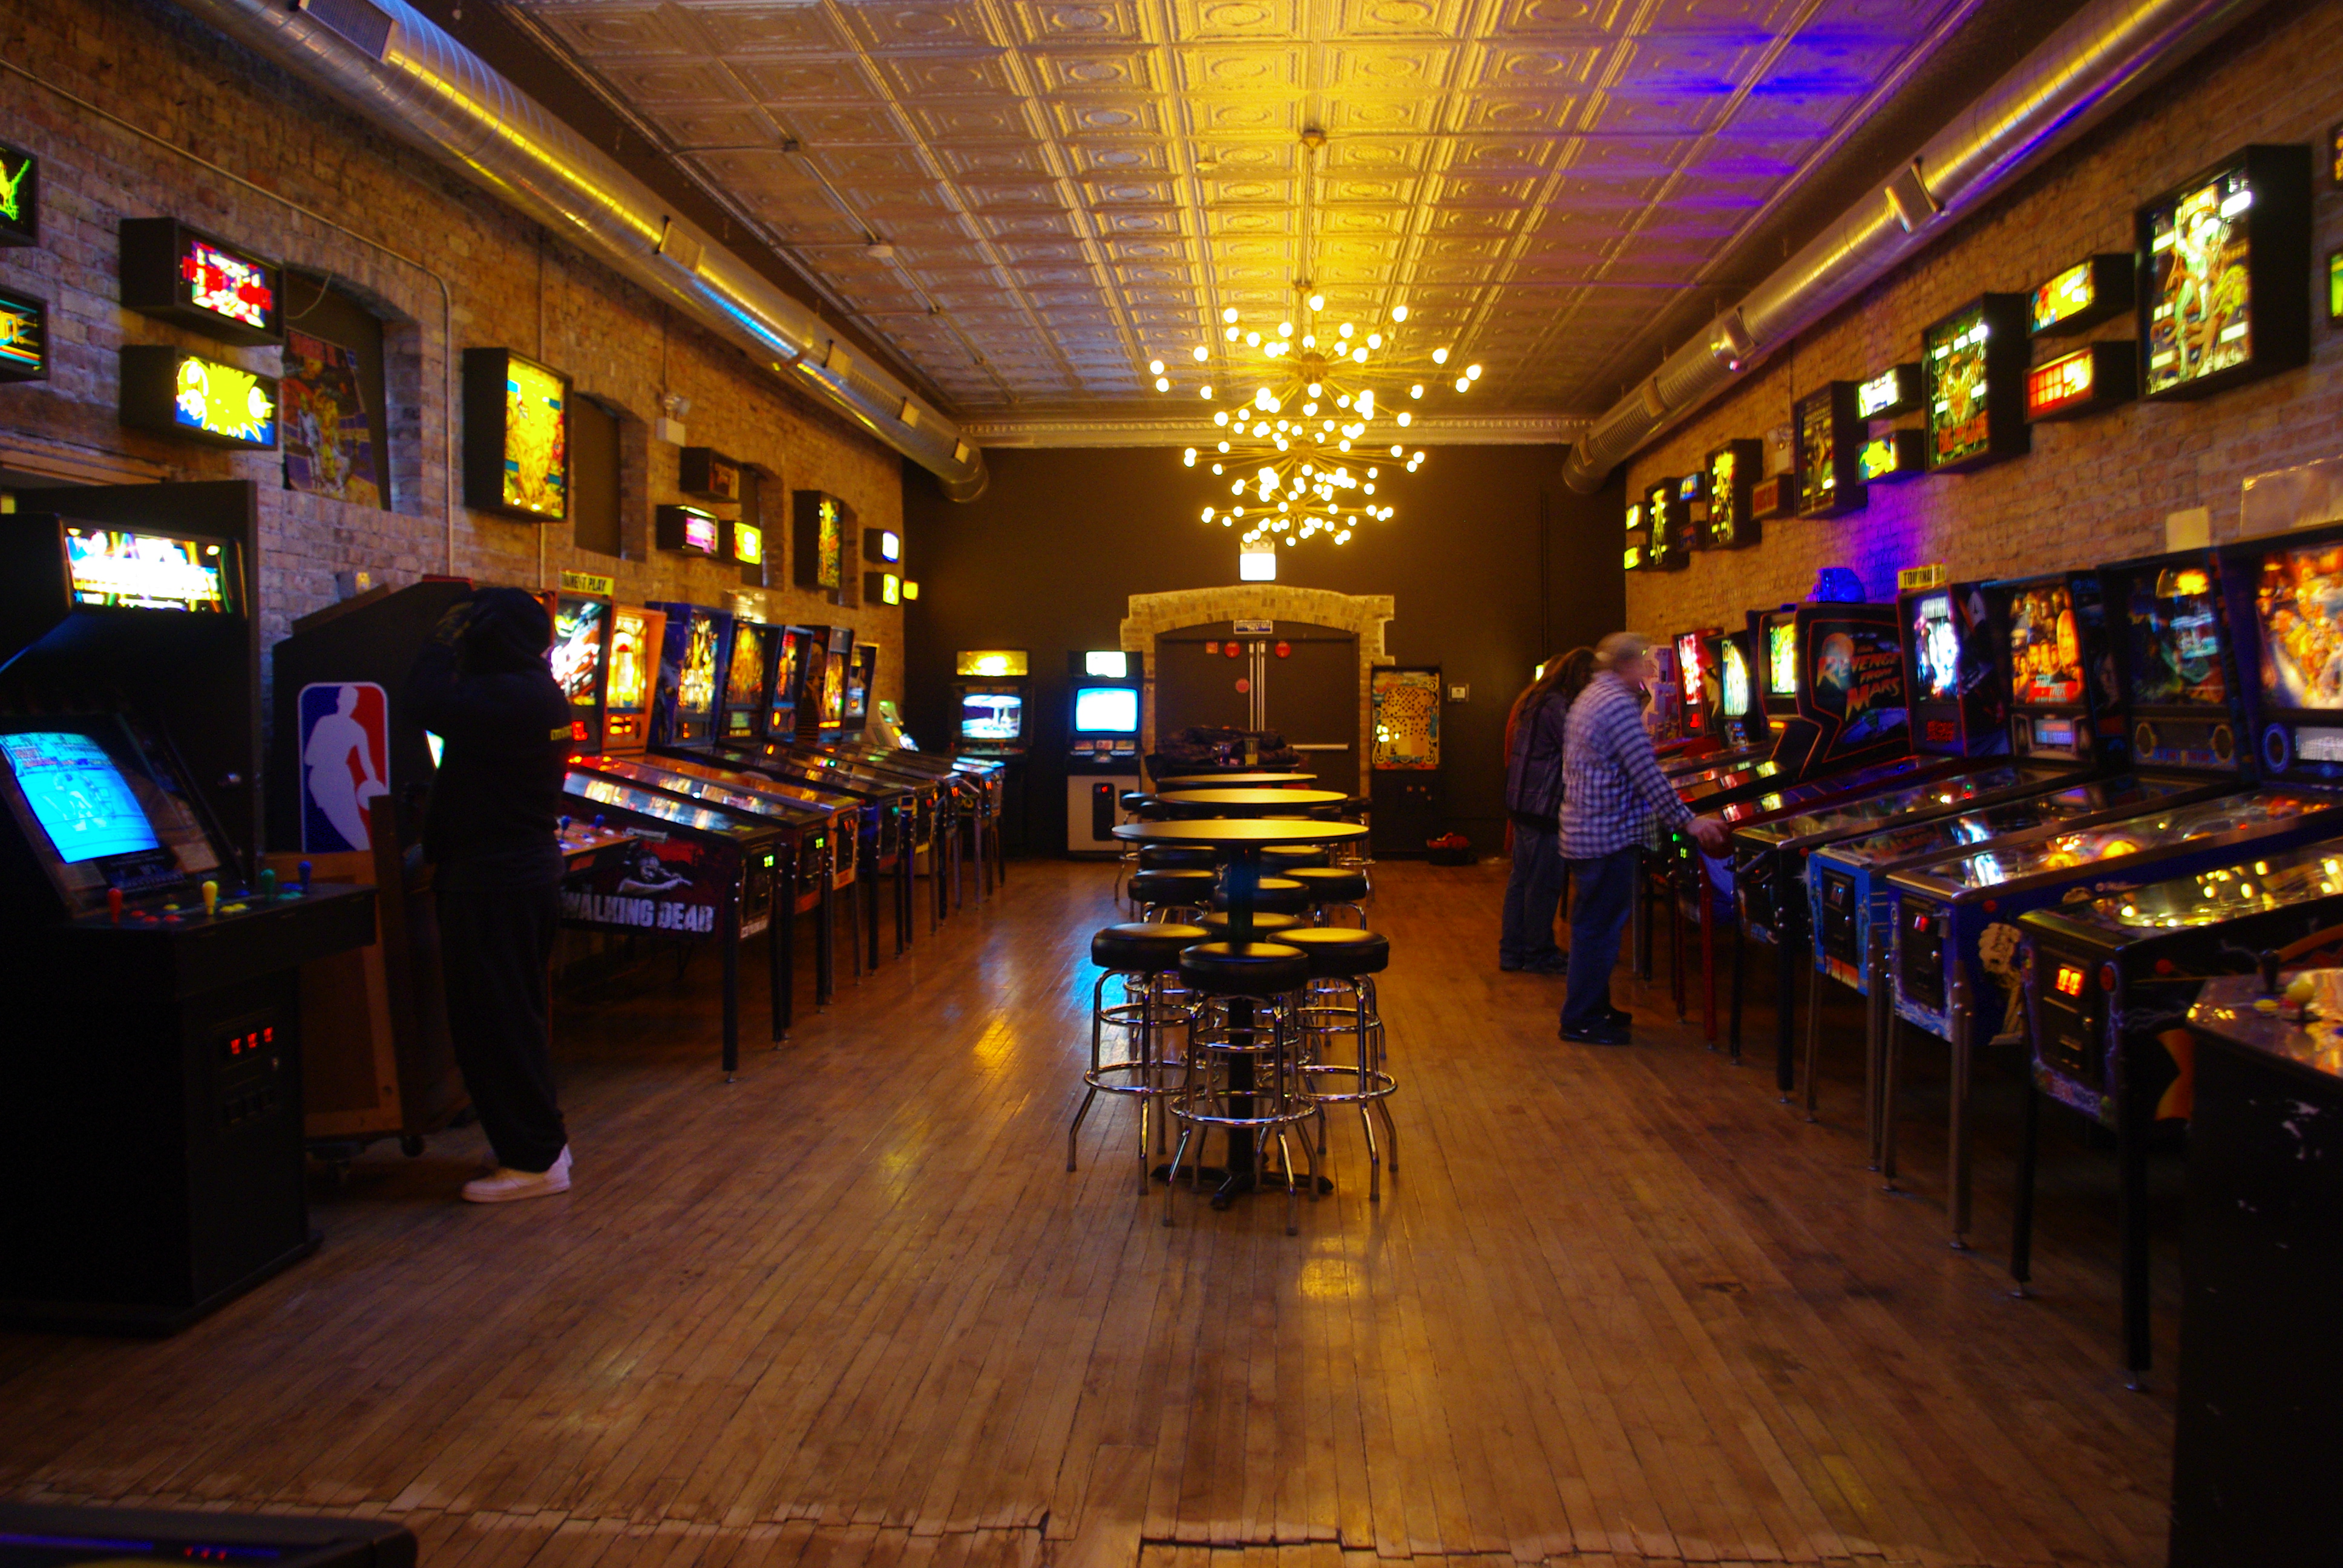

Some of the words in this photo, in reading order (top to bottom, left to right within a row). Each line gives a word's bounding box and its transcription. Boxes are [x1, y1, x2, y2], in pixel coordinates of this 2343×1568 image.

[588, 577, 606, 592] PLAY
[1816, 652, 1901, 690] REVENGE
[1846, 676, 1901, 721] MARS
[560, 891, 655, 928] WALKING
[657, 901, 716, 933] DEAD
